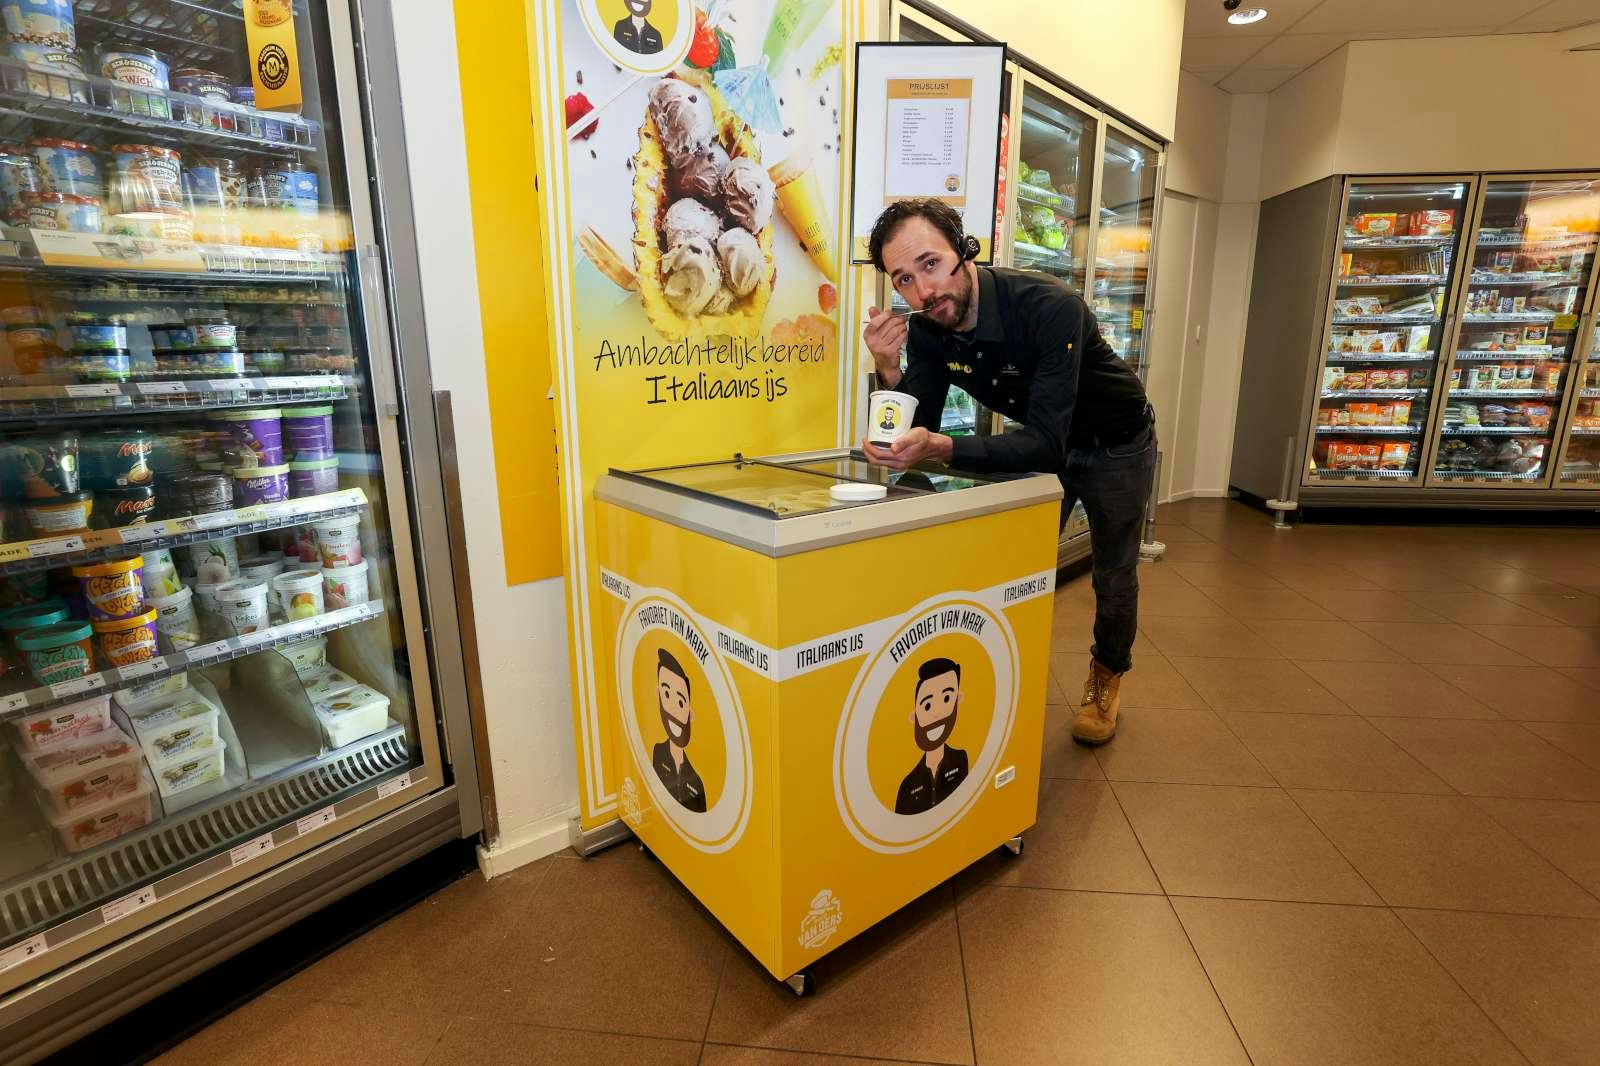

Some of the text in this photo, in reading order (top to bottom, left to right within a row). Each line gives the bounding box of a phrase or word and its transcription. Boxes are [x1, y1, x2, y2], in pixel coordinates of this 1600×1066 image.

[594, 336, 825, 371] Ambachtelijk bereid
[646, 369, 788, 404] Italiaans ijs
[602, 572, 623, 595] ITALIAANS
[1004, 576, 1047, 602] ITALIAANS IJS
[638, 605, 710, 665] FAVORIET VAN MARK
[717, 631, 769, 671] ITALIAANS IJS
[797, 633, 864, 669] ITALIAANS IJS
[889, 609, 987, 663] FAVORIET VAN MARK
